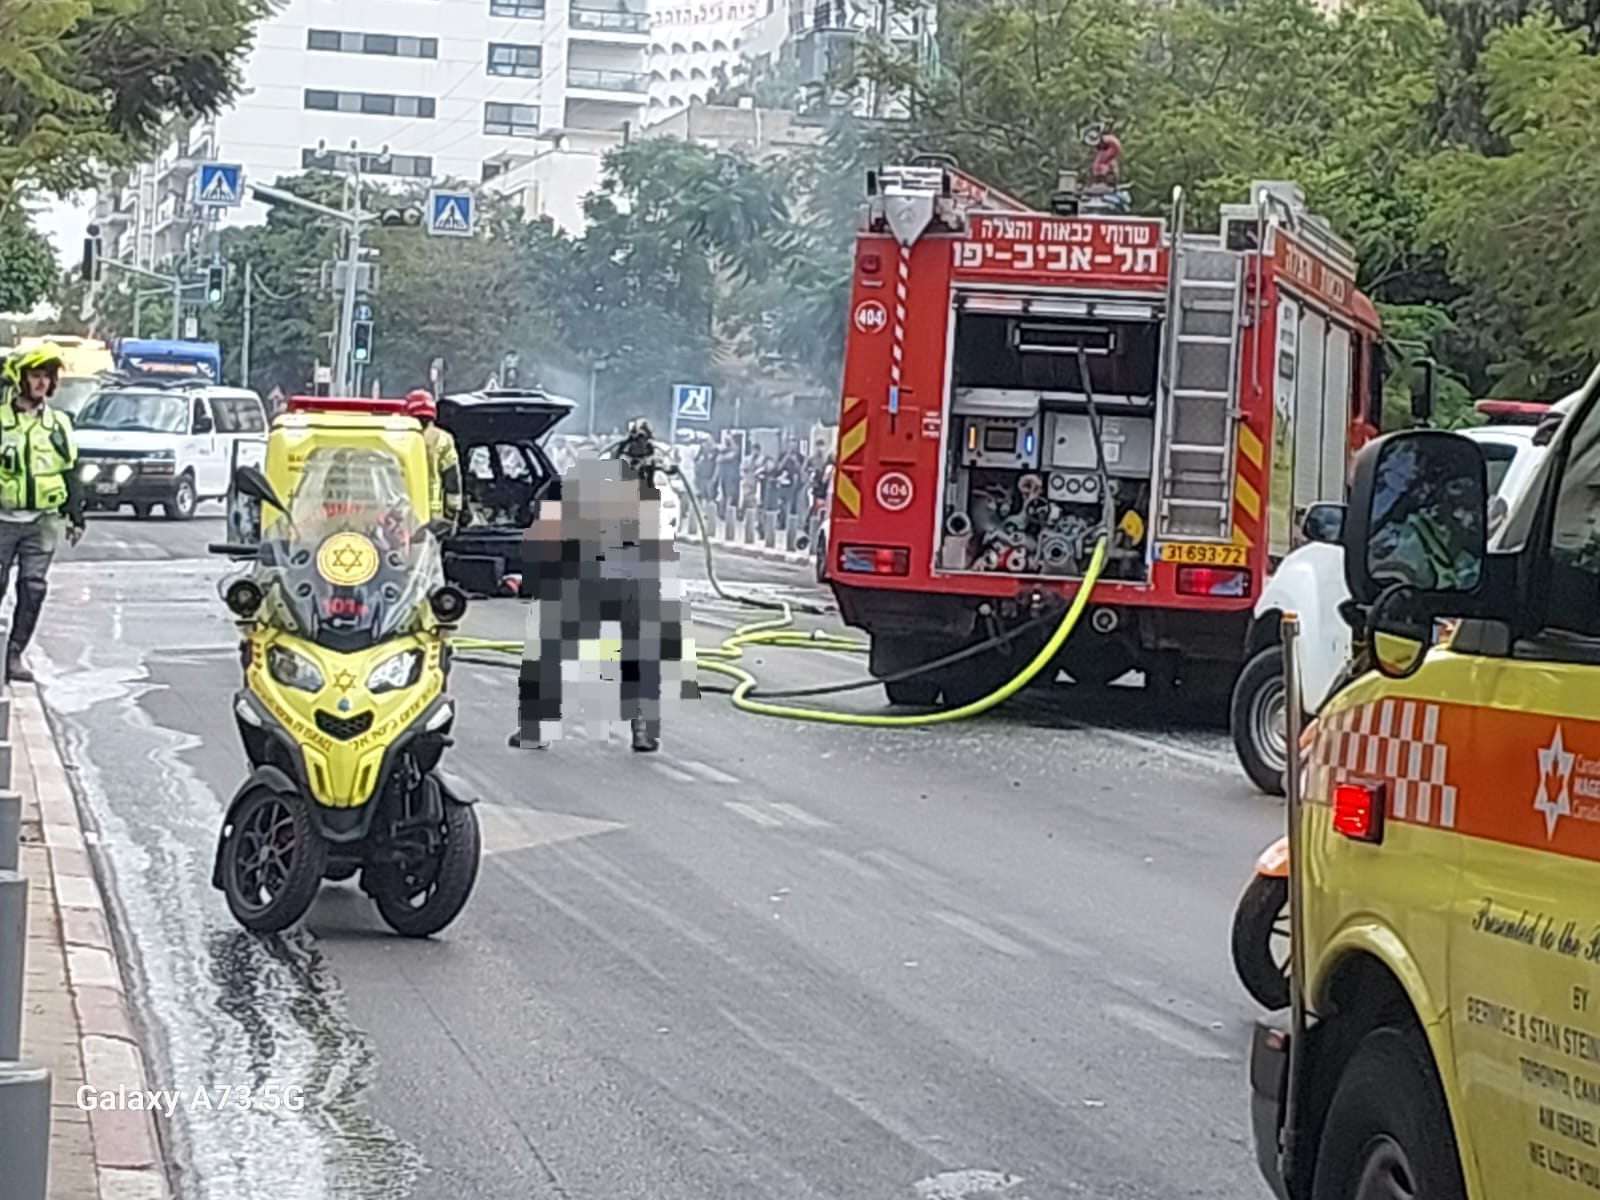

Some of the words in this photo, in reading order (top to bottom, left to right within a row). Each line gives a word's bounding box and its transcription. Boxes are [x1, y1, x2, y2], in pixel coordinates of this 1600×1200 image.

[981, 219, 1033, 240] והצלה
[1039, 221, 1092, 242] כבאות
[1100, 223, 1149, 245] שרותי
[953, 241, 1158, 273] תל-אביב-יפו
[857, 309, 884, 325] 404
[1472, 897, 1542, 945] Presented
[1540, 917, 1555, 950] to
[1558, 921, 1580, 958] the
[1573, 985, 1588, 1012] BY
[1530, 1016, 1560, 1052] STAN
[1557, 1111, 1597, 1148] ISRAEL
